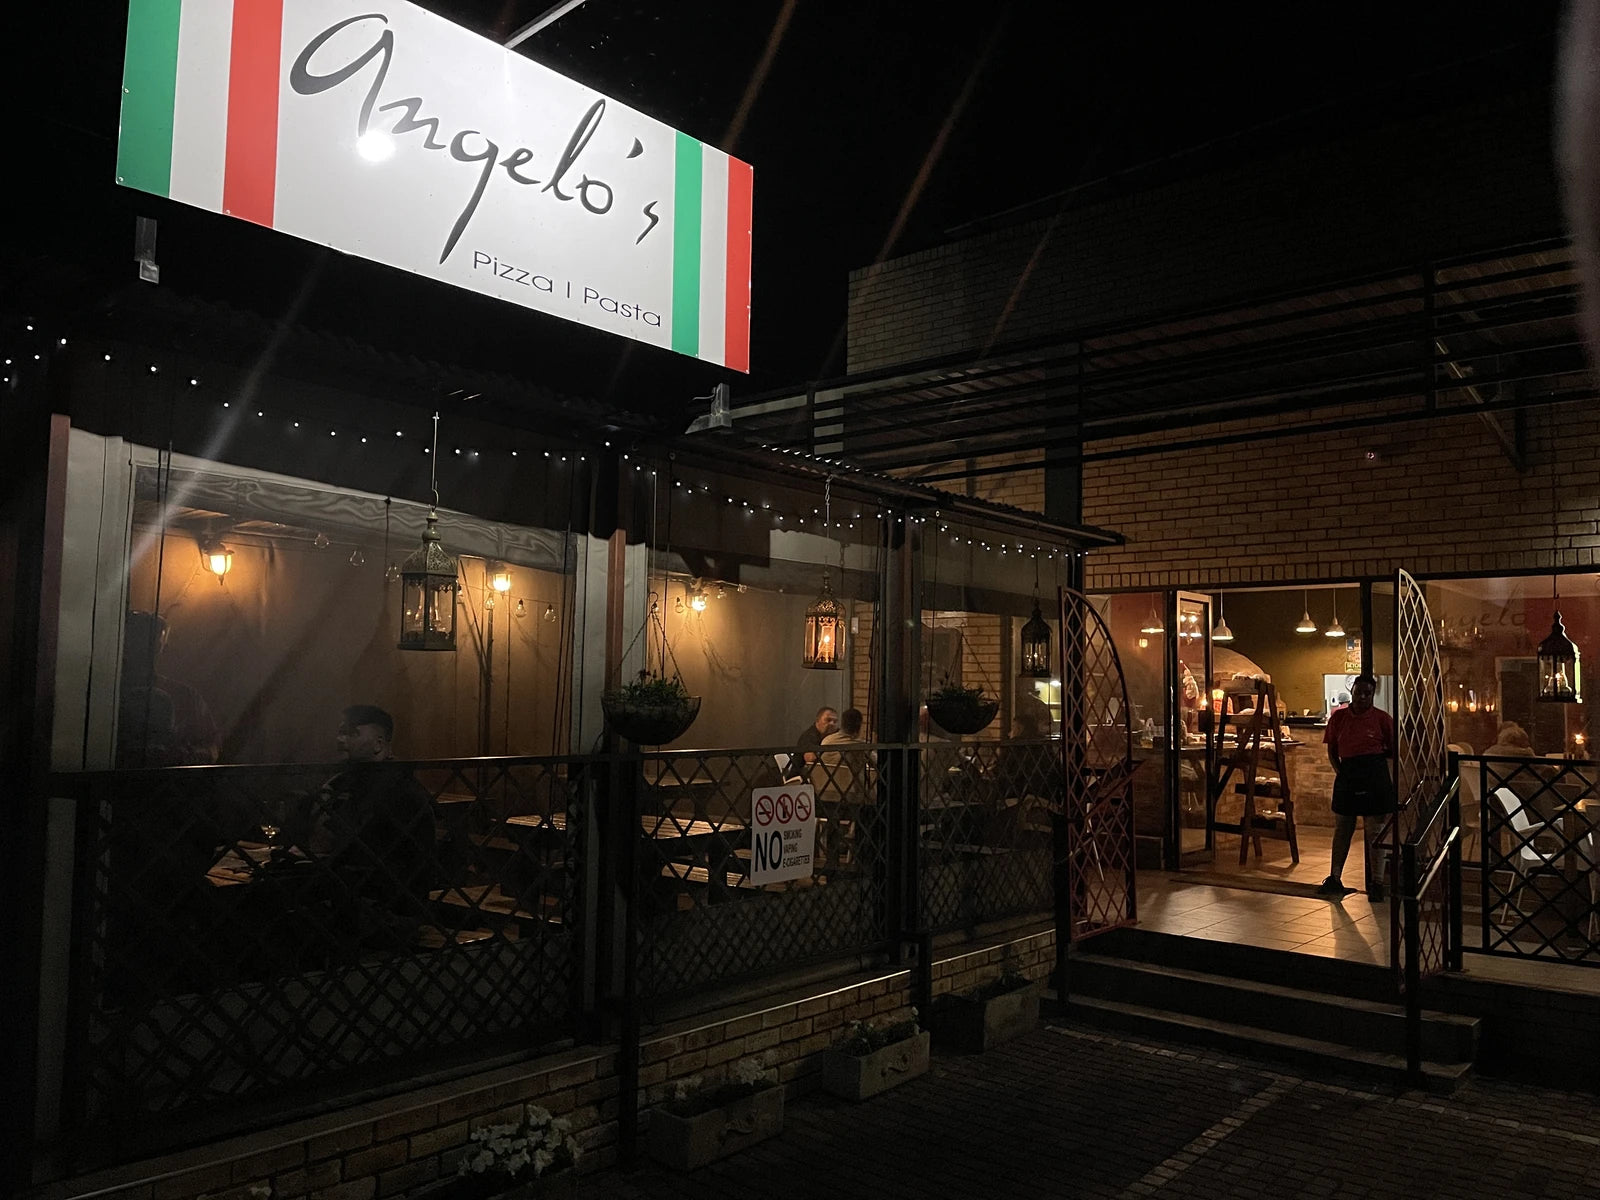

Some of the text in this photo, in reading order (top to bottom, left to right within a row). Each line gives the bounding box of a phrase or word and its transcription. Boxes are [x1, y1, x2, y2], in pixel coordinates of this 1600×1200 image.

[472, 250, 555, 294] Pizza
[583, 287, 663, 328] Pasta
[754, 830, 783, 872] NO
